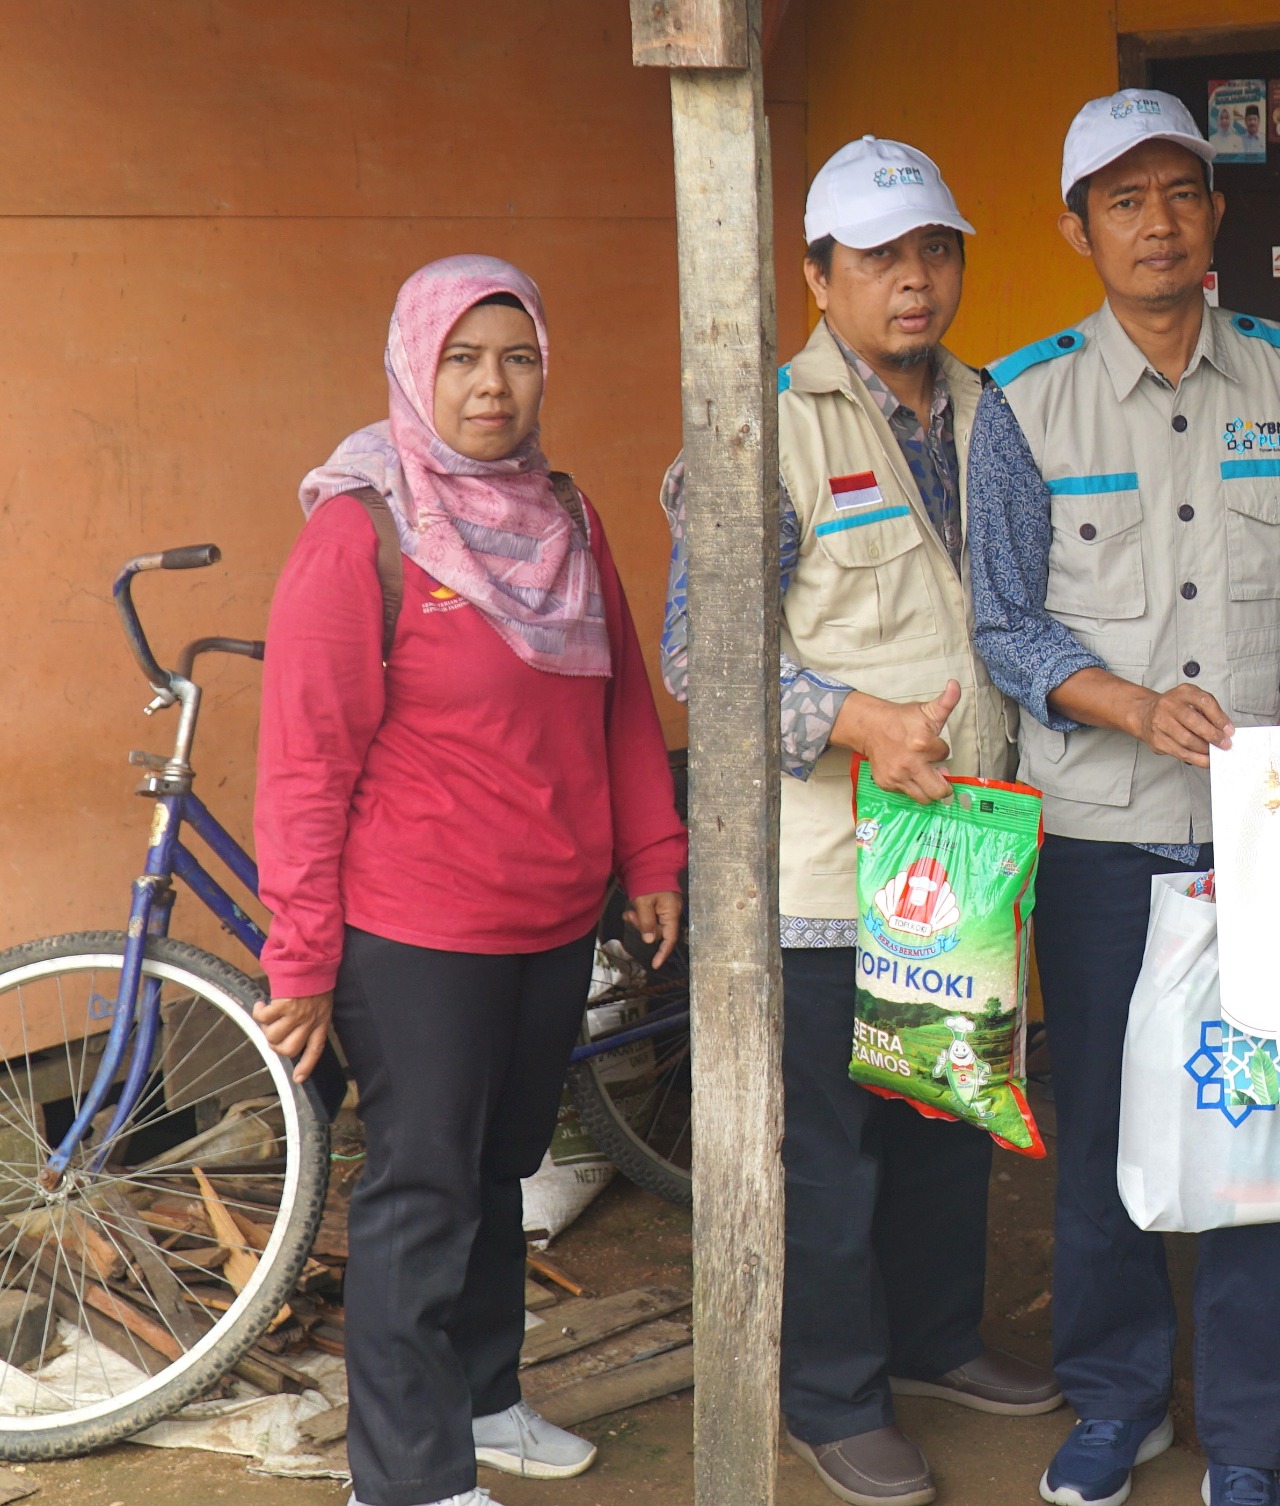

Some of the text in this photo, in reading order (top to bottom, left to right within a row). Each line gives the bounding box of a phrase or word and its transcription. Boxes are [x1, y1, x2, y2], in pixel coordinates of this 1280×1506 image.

[896, 167, 920, 175] YBM
[900, 174, 923, 182] PLN
[894, 918, 928, 933] TOPI KOKI
[877, 933, 936, 957] BERAS BERMUTU
[905, 964, 973, 998] KOKI
[853, 1016, 904, 1055] SETRA
